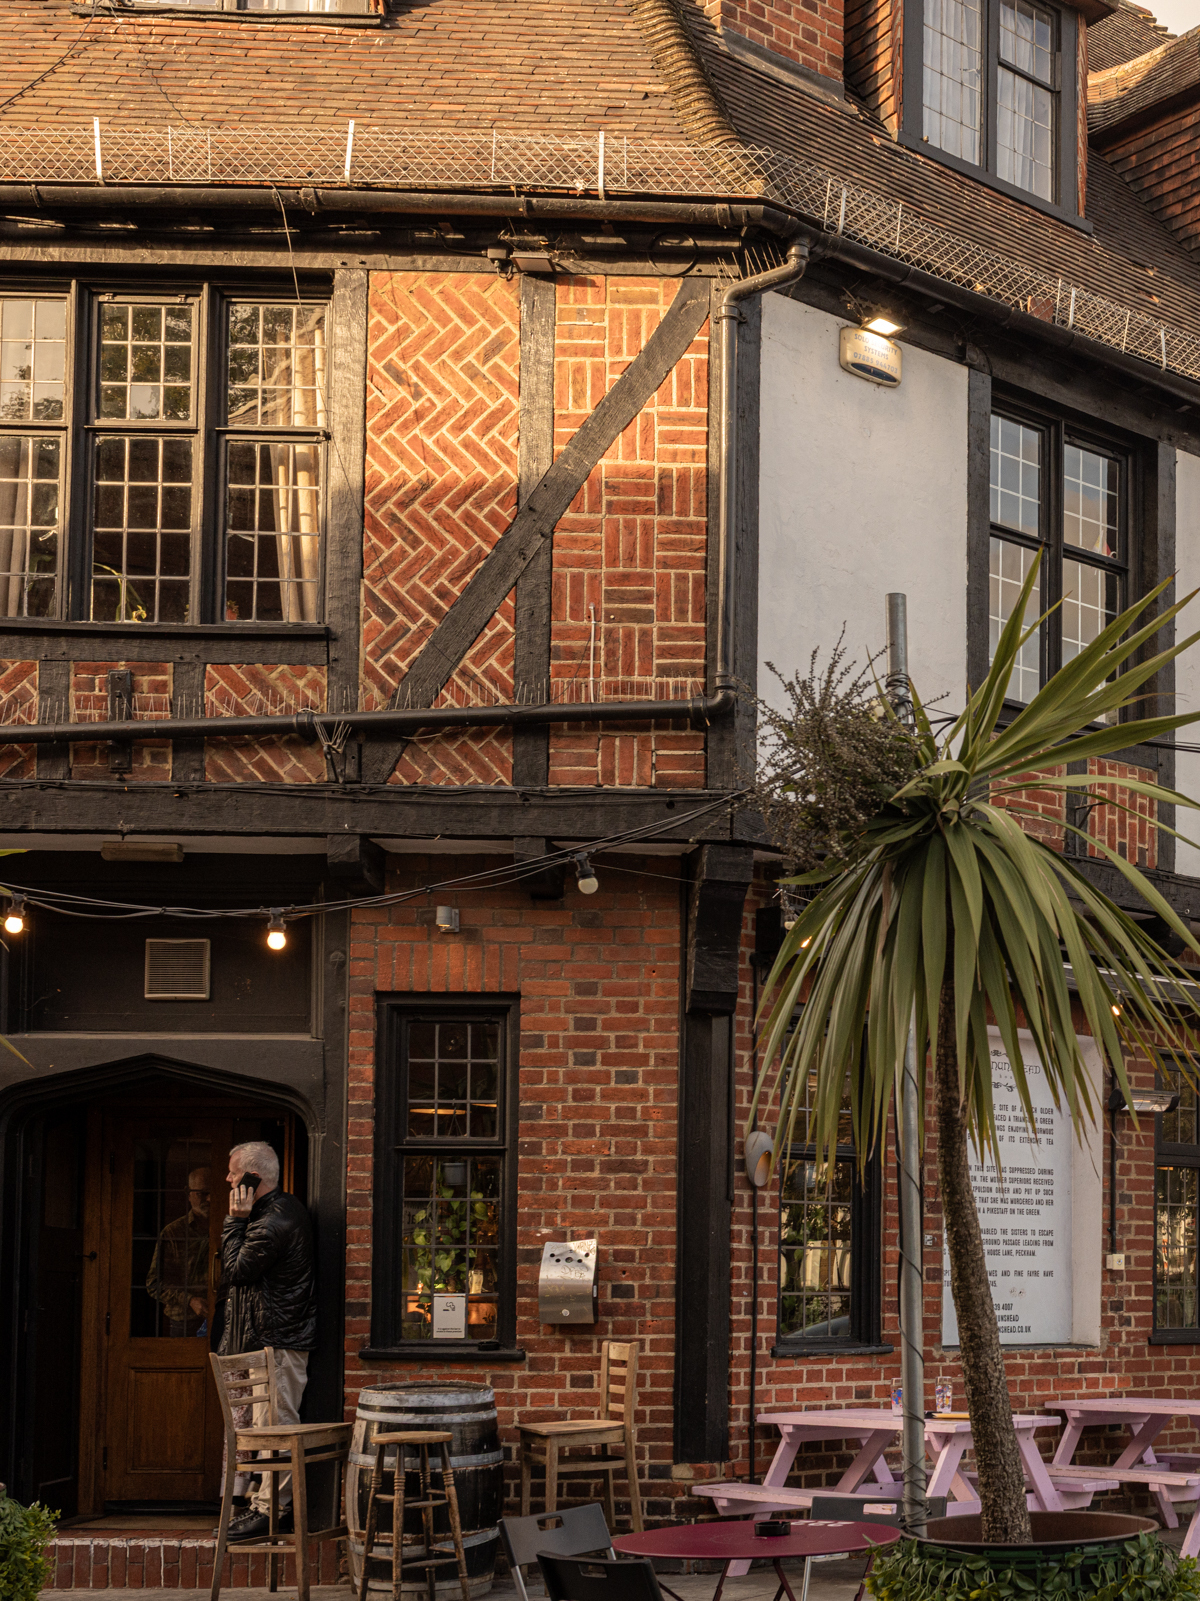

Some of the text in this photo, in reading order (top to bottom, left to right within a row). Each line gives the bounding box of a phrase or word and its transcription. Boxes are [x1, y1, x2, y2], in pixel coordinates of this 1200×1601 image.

[864, 345, 889, 360] SYSTEMS
[991, 1061, 1012, 1072] NUN
[999, 1104, 1009, 1112] SITE
[1040, 1107, 1054, 1115] OLDER
[1039, 1117, 1054, 1125] GREEN
[986, 1165, 996, 1173] SITE
[1008, 1166, 1036, 1175] SUPPRESSED
[1037, 1168, 1054, 1176] DURING
[979, 1175, 989, 1183] THE
[1008, 1177, 1032, 1185] SUPERIORS
[1032, 1178, 1054, 1186] RECEIVED
[972, 1185, 993, 1193] XPULSION
[1012, 1187, 1022, 1195] AND
[1042, 1188, 1054, 1196] SUCH
[978, 1196, 989, 1204] THAT
[990, 1196, 999, 1204] SHE
[1009, 1197, 1034, 1206] MURDERED
[1035, 1198, 1045, 1206] AND
[986, 1207, 1009, 1215] PIKESTAFF
[1000, 1228, 1008, 1236] THE
[1010, 1228, 1028, 1236] SISTERS
[1038, 1229, 1054, 1237] ESCAPE
[1002, 1238, 1021, 1246] PASSAGE
[1022, 1239, 1041, 1247] LEADING
[1042, 1239, 1054, 1247] FROM
[986, 1248, 1001, 1256] HOUSE
[1001, 1269, 1011, 1277] AND
